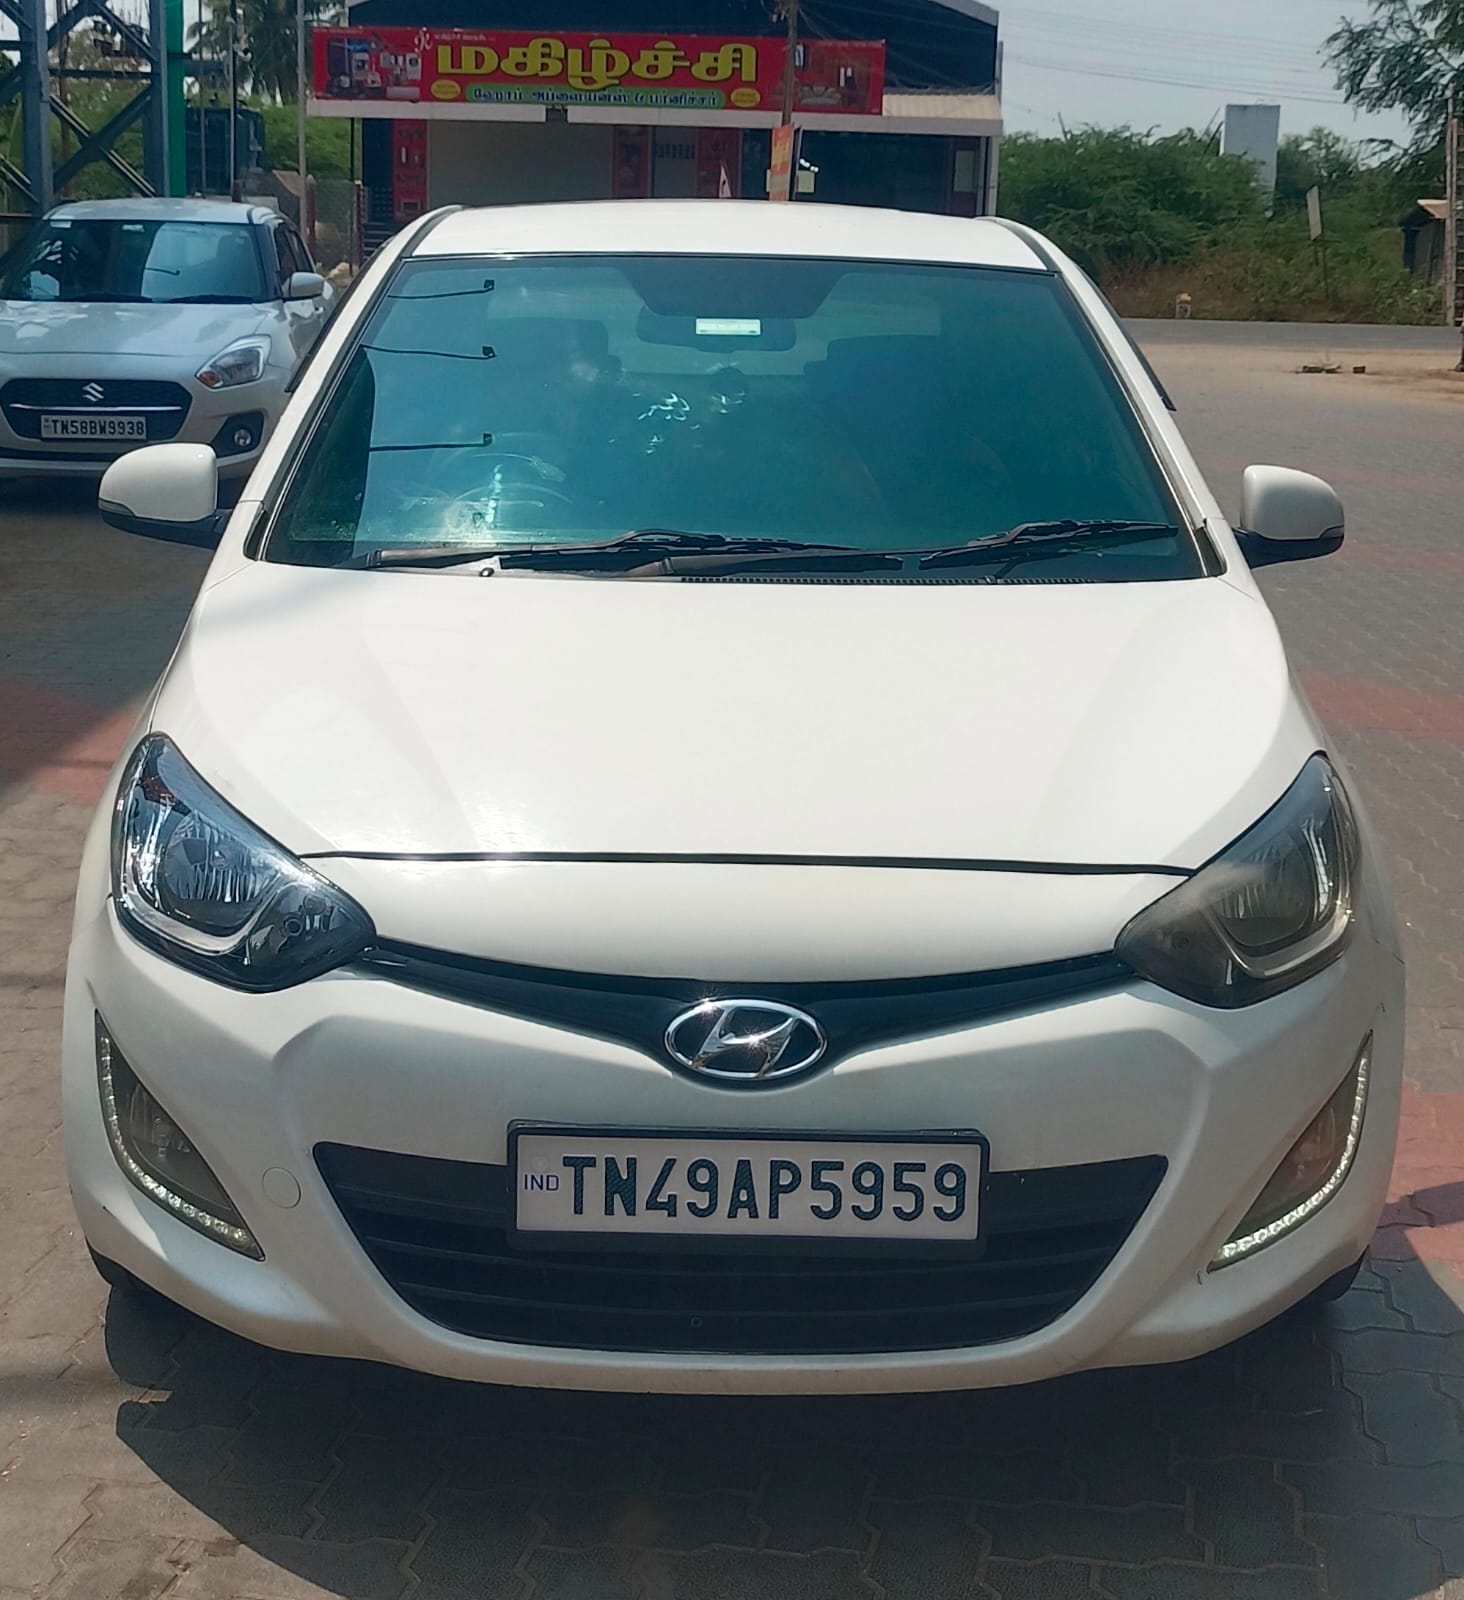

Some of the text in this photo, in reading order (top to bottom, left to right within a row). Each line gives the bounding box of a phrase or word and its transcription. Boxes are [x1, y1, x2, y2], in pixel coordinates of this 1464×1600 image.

[437, 37, 757, 91] மகிழ்ச்சி
[51, 419, 144, 435] TN58BW9938
[524, 1174, 559, 1191] IND
[563, 1156, 967, 1221] TN49AP5959
